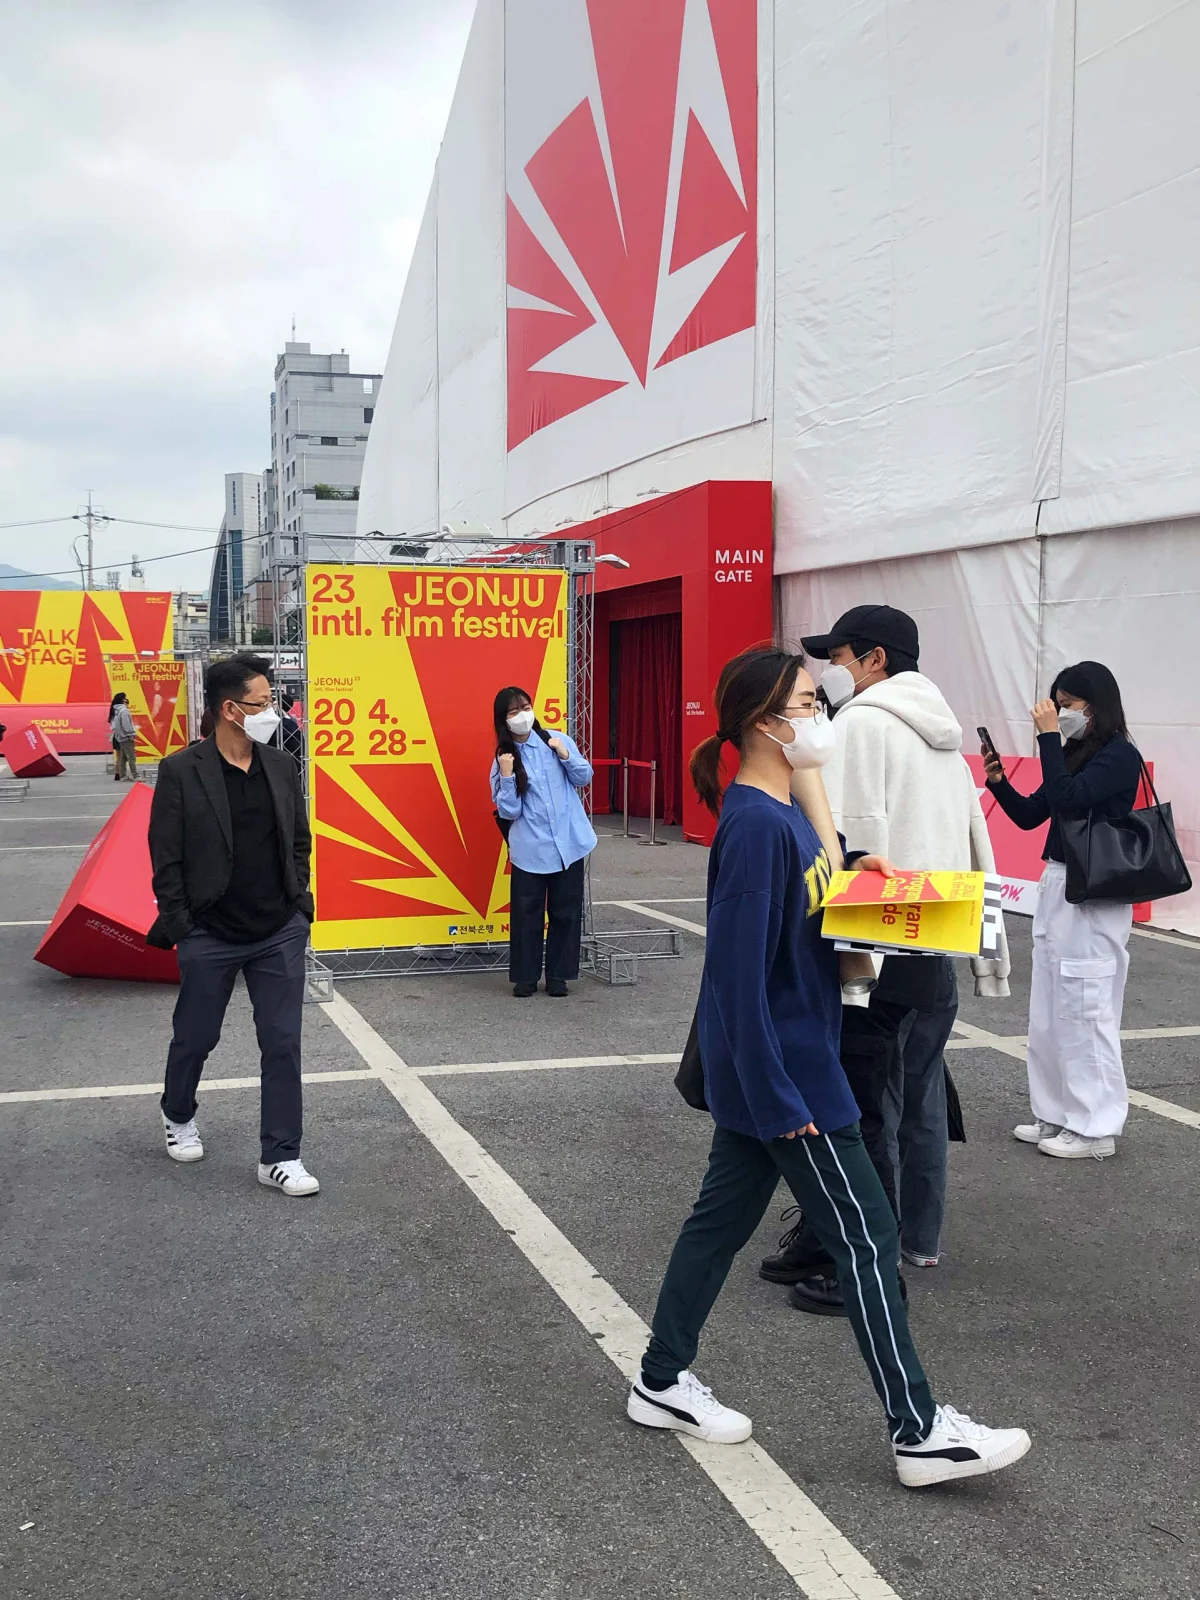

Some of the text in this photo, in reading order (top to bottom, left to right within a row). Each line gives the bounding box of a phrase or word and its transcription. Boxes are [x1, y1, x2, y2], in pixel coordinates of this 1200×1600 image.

[715, 550, 764, 564] MAIN
[714, 570, 753, 583] GATE
[312, 574, 545, 607] 23 JEONJU
[312, 606, 563, 638] intl. film festival
[18, 628, 76, 645] TALK
[12, 648, 87, 666] STAGE
[112, 663, 179, 673] 23 JEONJU
[112, 672, 185, 682] intl. film festival
[314, 677, 353, 686] JEONJU
[314, 698, 399, 726] 20 4.
[315, 729, 355, 756] 22
[459, 924, 495, 935] 전북은행
